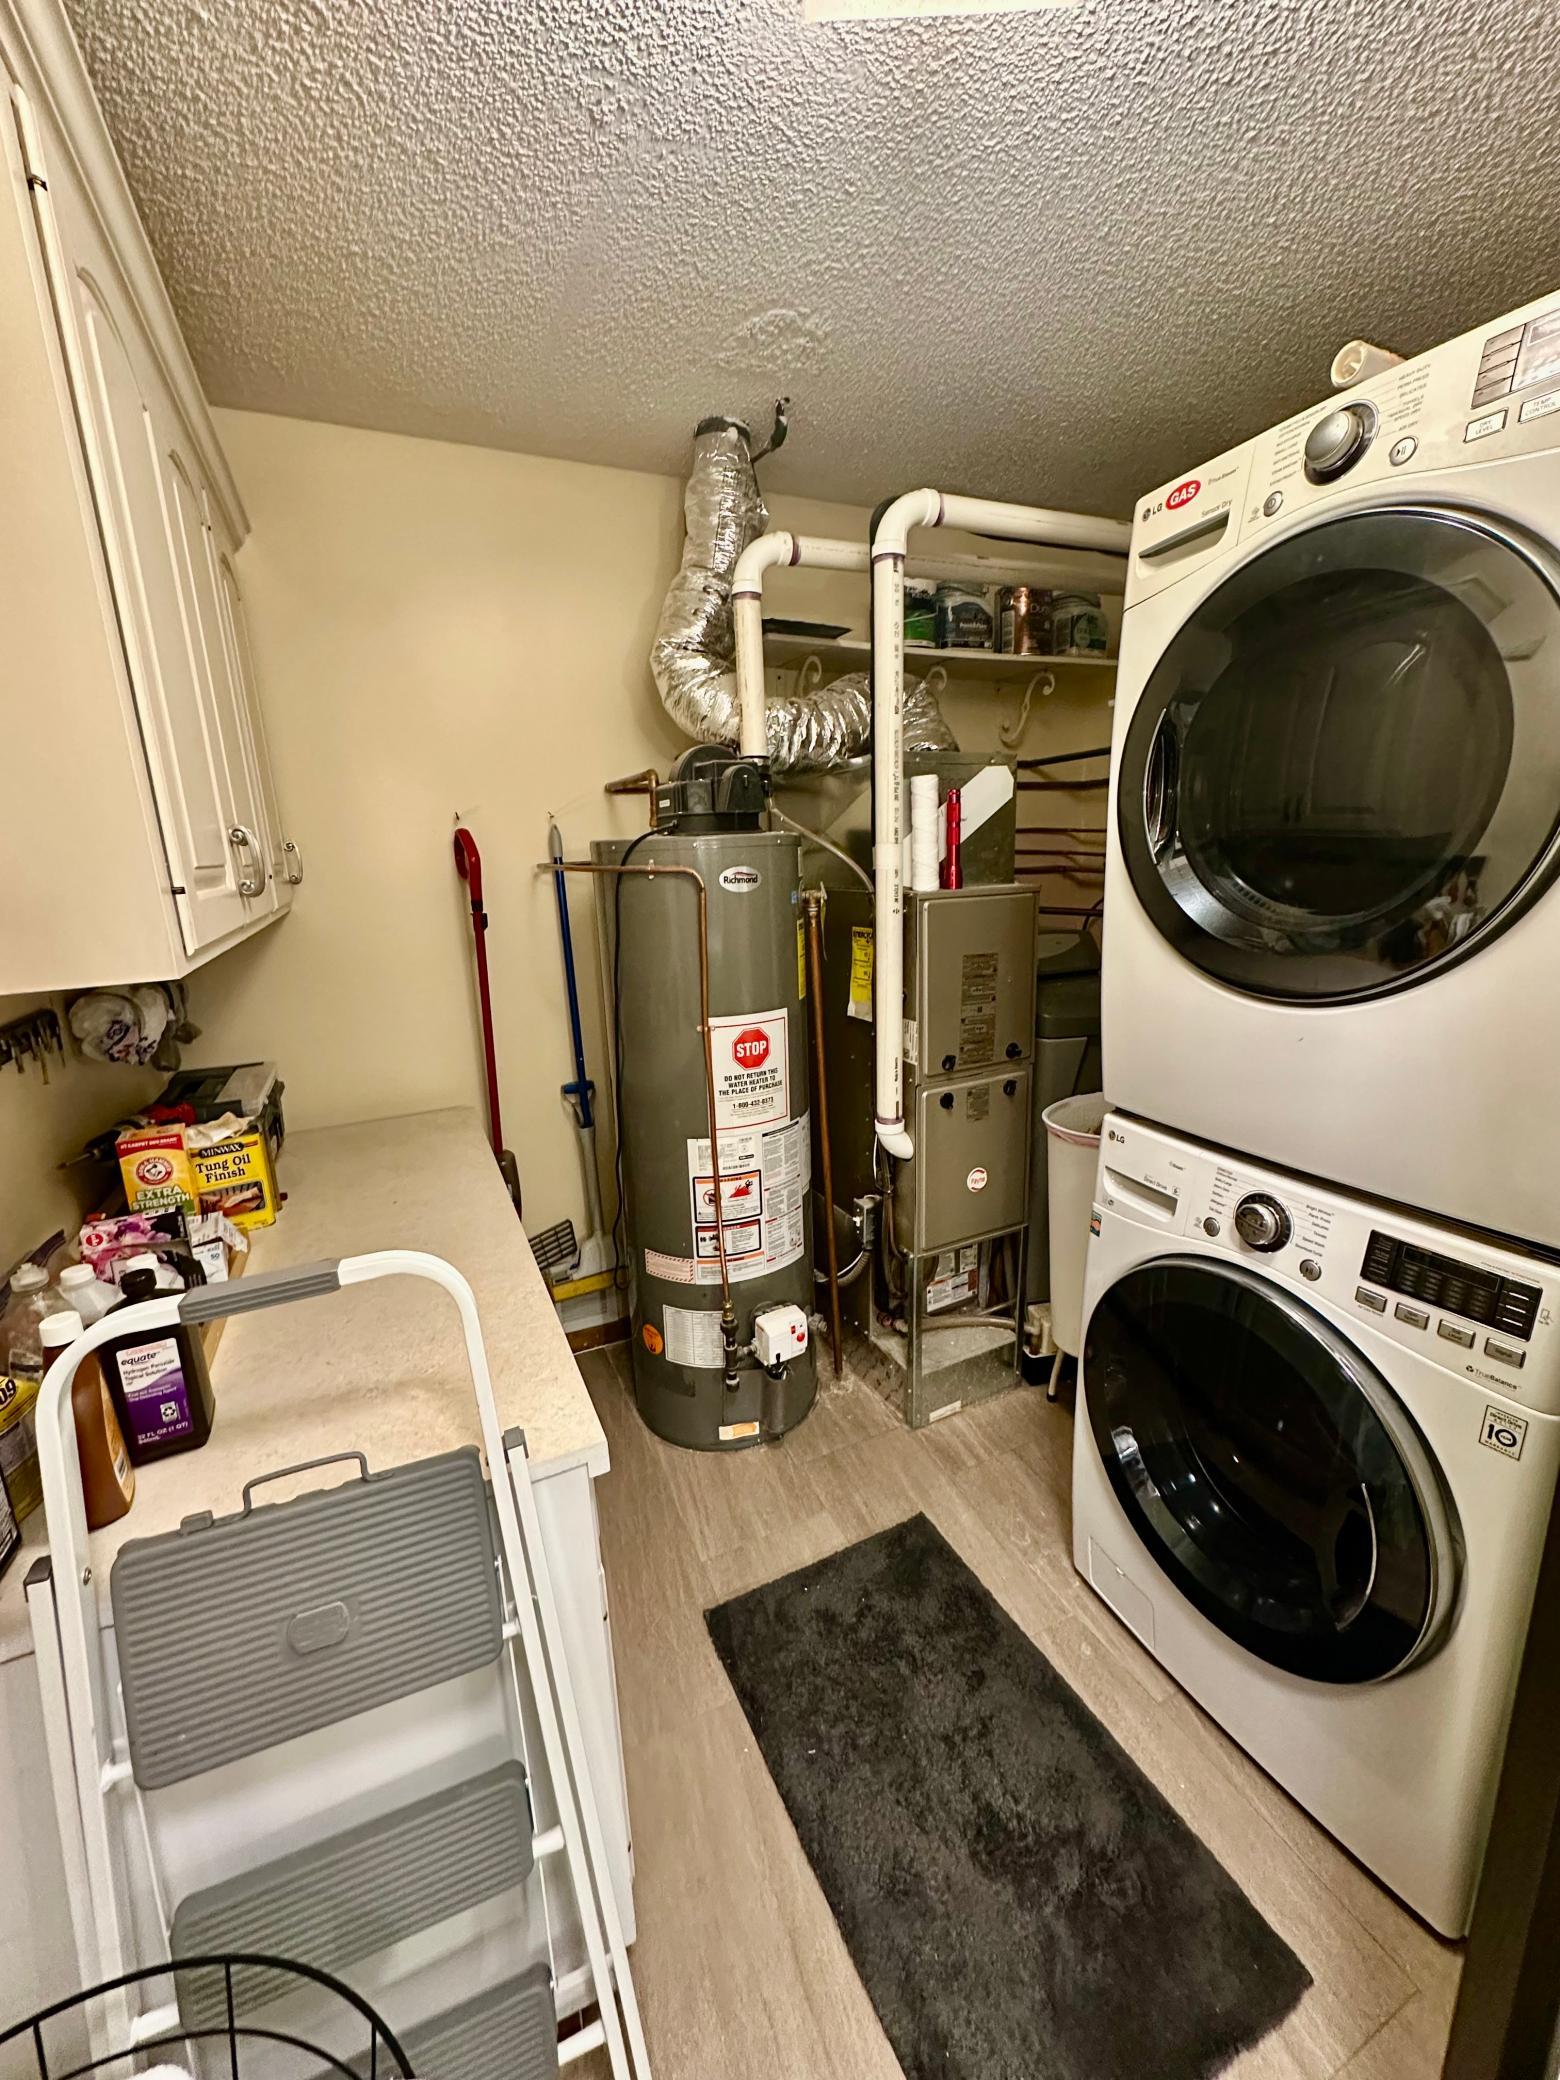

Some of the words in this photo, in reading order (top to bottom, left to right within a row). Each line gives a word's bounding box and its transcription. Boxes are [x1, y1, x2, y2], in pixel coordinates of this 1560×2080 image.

[1152, 503, 1163, 515] LG
[1169, 483, 1198, 506] GAS
[723, 874, 758, 885] Richmond
[736, 1040, 767, 1058] STOP
[734, 1073, 745, 1081] NOT
[746, 1070, 767, 1080] RETURN
[768, 1067, 778, 1076] THIS
[719, 1089, 730, 1097] THE
[731, 1087, 749, 1095] PLACE
[758, 1080, 783, 1091] PURCHASE
[728, 1080, 748, 1089] WATER
[749, 1077, 769, 1087] HEATER
[1116, 1134, 1125, 1144] LG
[201, 1143, 241, 1158] MINWAX
[195, 1159, 230, 1174] Tung
[232, 1153, 251, 1166] Oil
[204, 1167, 246, 1183] Finish
[136, 1184, 182, 1200] EXTRA
[132, 1192, 190, 1210] STRENGTH
[120, 1352, 157, 1366] equate
[123, 1364, 150, 1376] Hydrogen
[124, 1372, 144, 1381] Topical
[145, 1367, 168, 1377] Solution
[156, 1427, 168, 1435] OZ
[175, 1421, 189, 1430] QT)
[1487, 1423, 1517, 1448] 10
